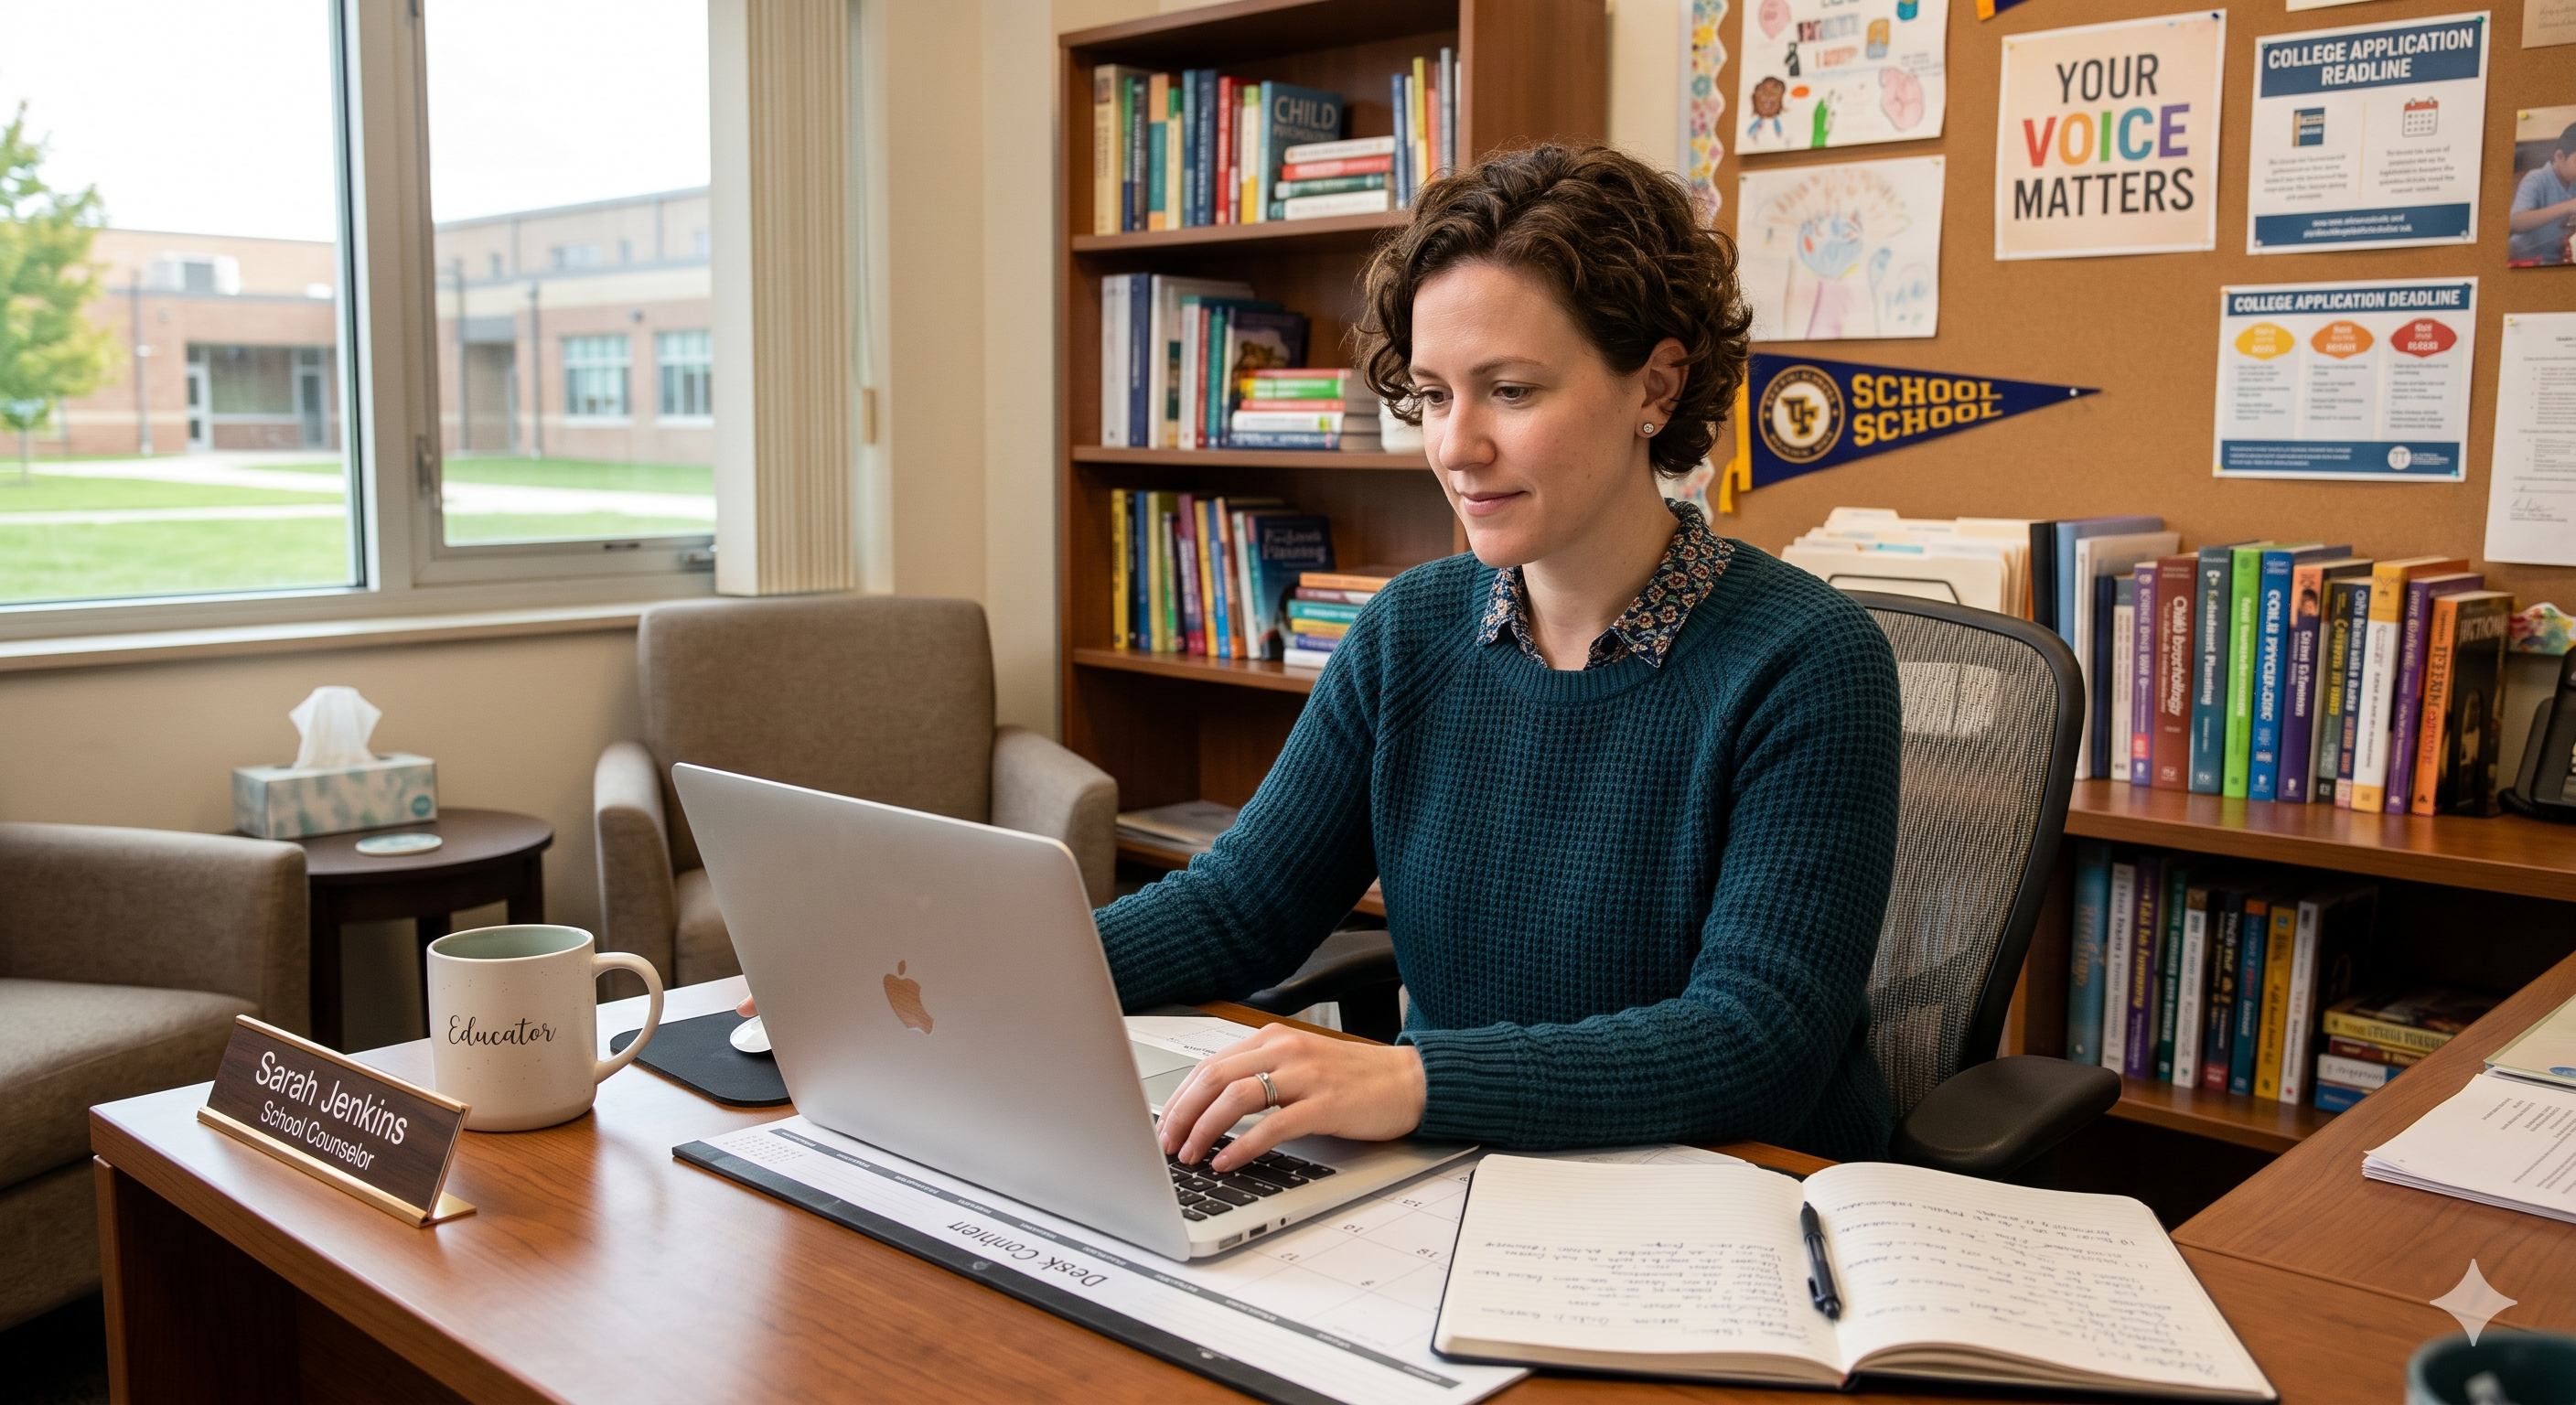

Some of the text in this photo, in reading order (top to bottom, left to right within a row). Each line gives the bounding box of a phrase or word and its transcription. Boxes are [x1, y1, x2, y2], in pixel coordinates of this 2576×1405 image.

[2268, 27, 2474, 70] COLLEGE APPLICATION
[2055, 53, 2160, 104] YOUR
[2321, 58, 2412, 86] READLINE
[1273, 95, 1337, 131] CHILD
[2023, 103, 2191, 168] VOICE
[2013, 167, 2195, 221] MATTERS
[2234, 289, 2461, 313] COLLEGE APPLICATION DEADLINE
[1852, 373, 2003, 410] SCHOOL
[1852, 401, 2003, 448] SCHOOL
[448, 1014, 557, 1046] Educator
[255, 1051, 408, 1144] Sarah Jenkins
[261, 1100, 375, 1171] School Counselor
